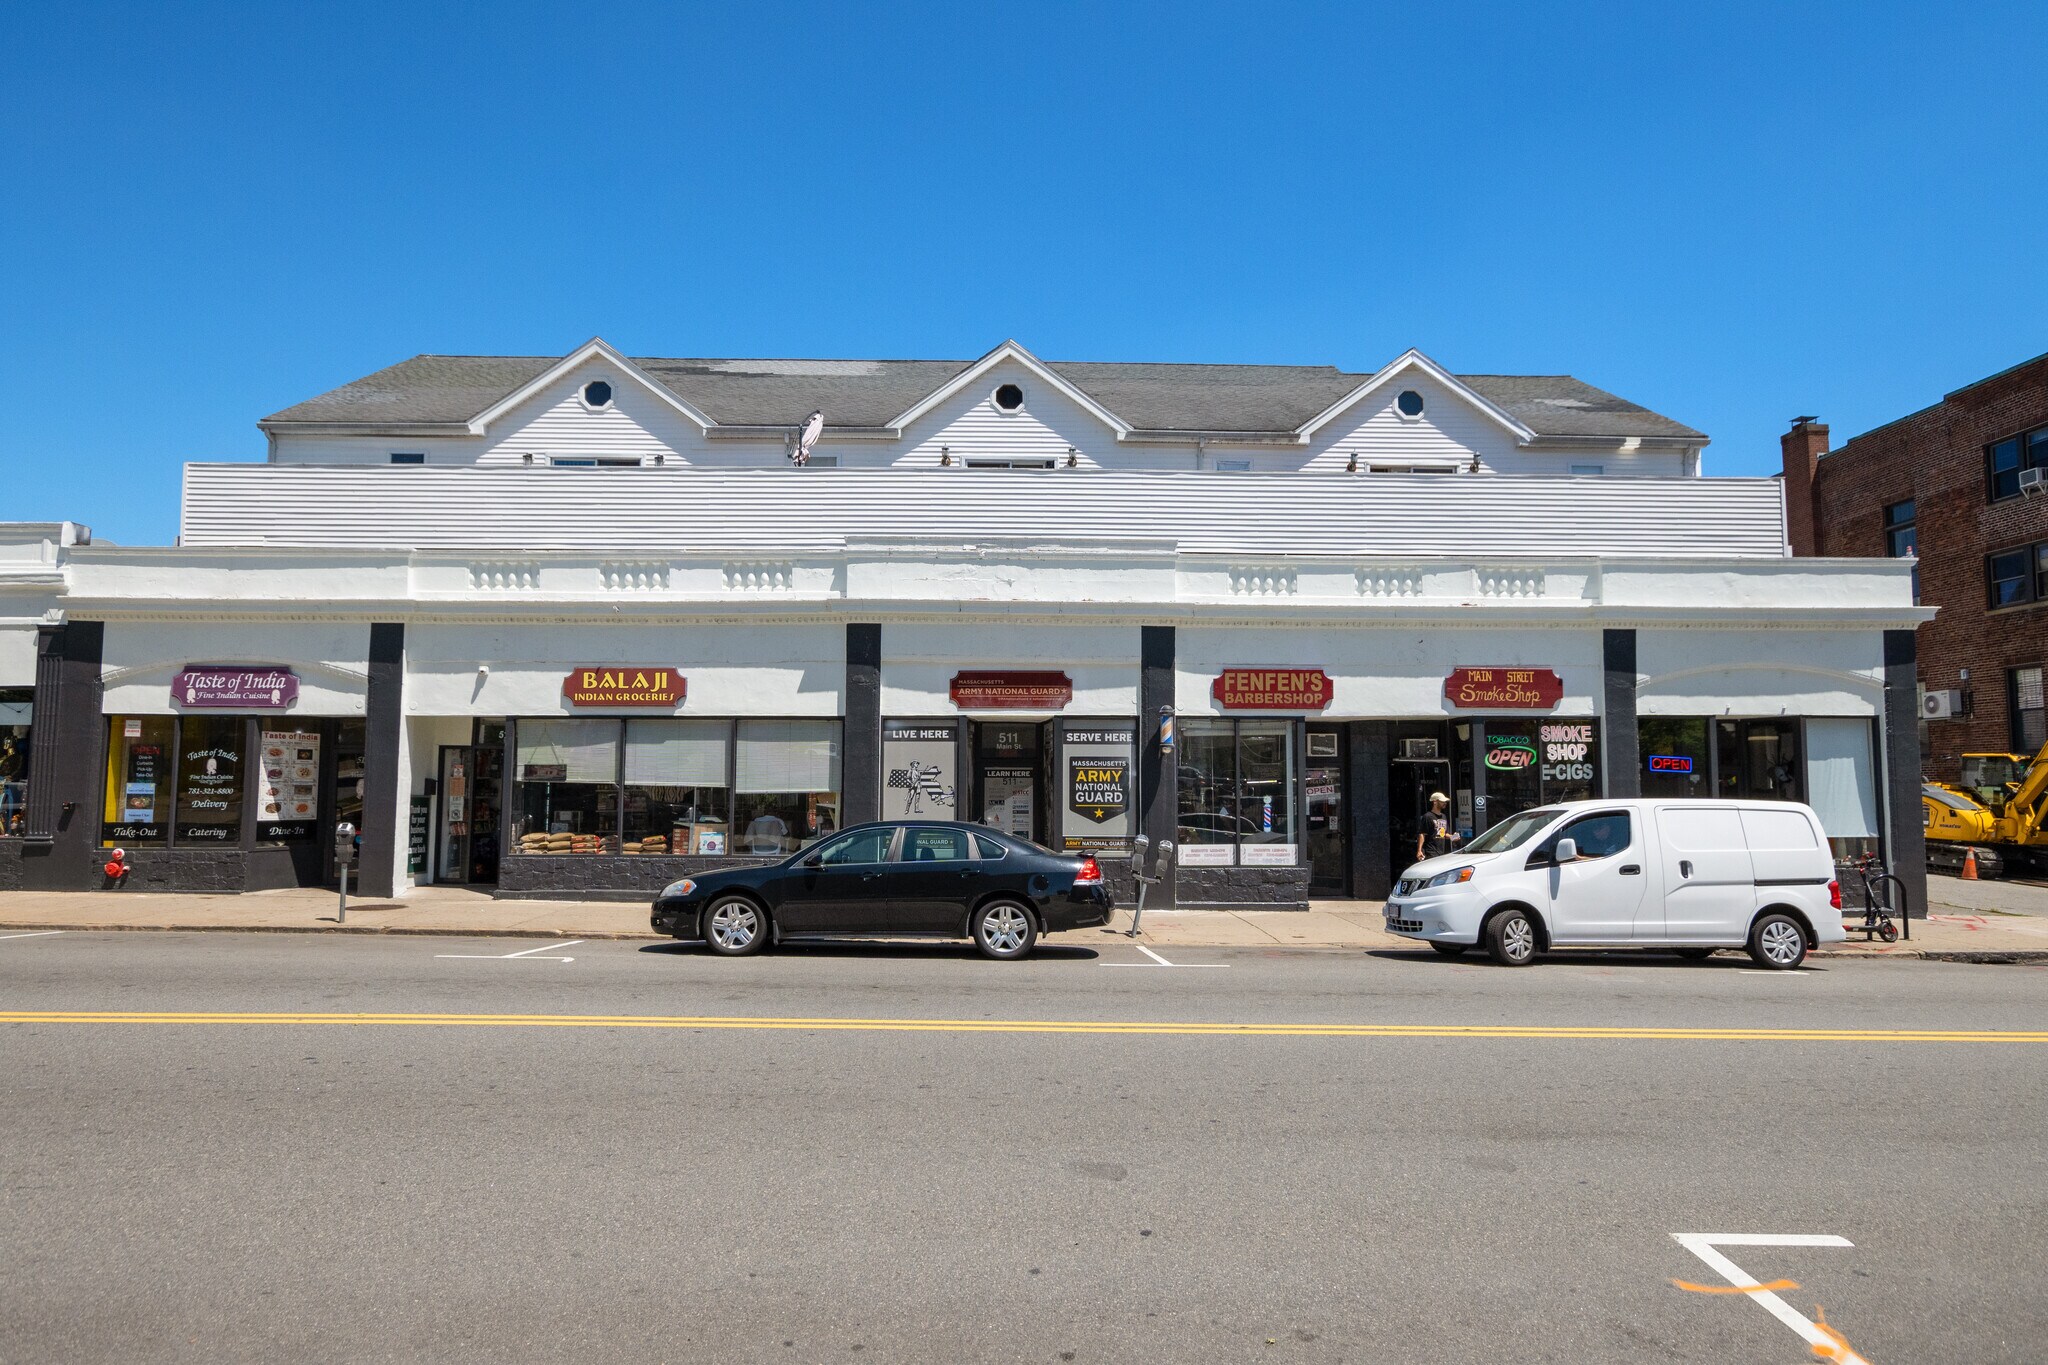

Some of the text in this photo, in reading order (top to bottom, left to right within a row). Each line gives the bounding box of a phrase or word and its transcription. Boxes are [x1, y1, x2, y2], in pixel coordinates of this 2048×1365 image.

[184, 671, 286, 694] Taste of India
[583, 671, 668, 692] BALAJI
[1224, 673, 1323, 691] FENFEN'S
[1468, 671, 1534, 683] MAIN STREET
[197, 691, 214, 700] Fine
[216, 691, 241, 699] Indian
[574, 693, 675, 701] INDIAN GROCERIES
[1225, 693, 1323, 704] BARBERSHOP
[1460, 684, 1541, 707] Smoke Shop
[264, 732, 286, 740] Taste
[892, 730, 949, 739] LIVE HERE
[999, 732, 1018, 743] 511
[1066, 733, 1133, 742] SERVE HERE
[1487, 735, 1530, 744] TOBACCO
[1541, 725, 1593, 743] SMOKE
[187, 748, 239, 762] Taste of India
[1547, 743, 1588, 761] SHOP
[1488, 749, 1532, 767] OPEN
[1652, 757, 1690, 770] OPEN
[1076, 770, 1122, 782] ARMY
[1542, 764, 1593, 780] E-CIGS
[1075, 783, 1123, 791] NATIONAL
[1306, 786, 1333, 795] OPEN
[1075, 792, 1123, 803] GUARD
[191, 799, 228, 810] Delivery
[113, 827, 158, 837] Take-Out
[188, 828, 227, 839] Catering
[269, 826, 304, 836] Dine-In
